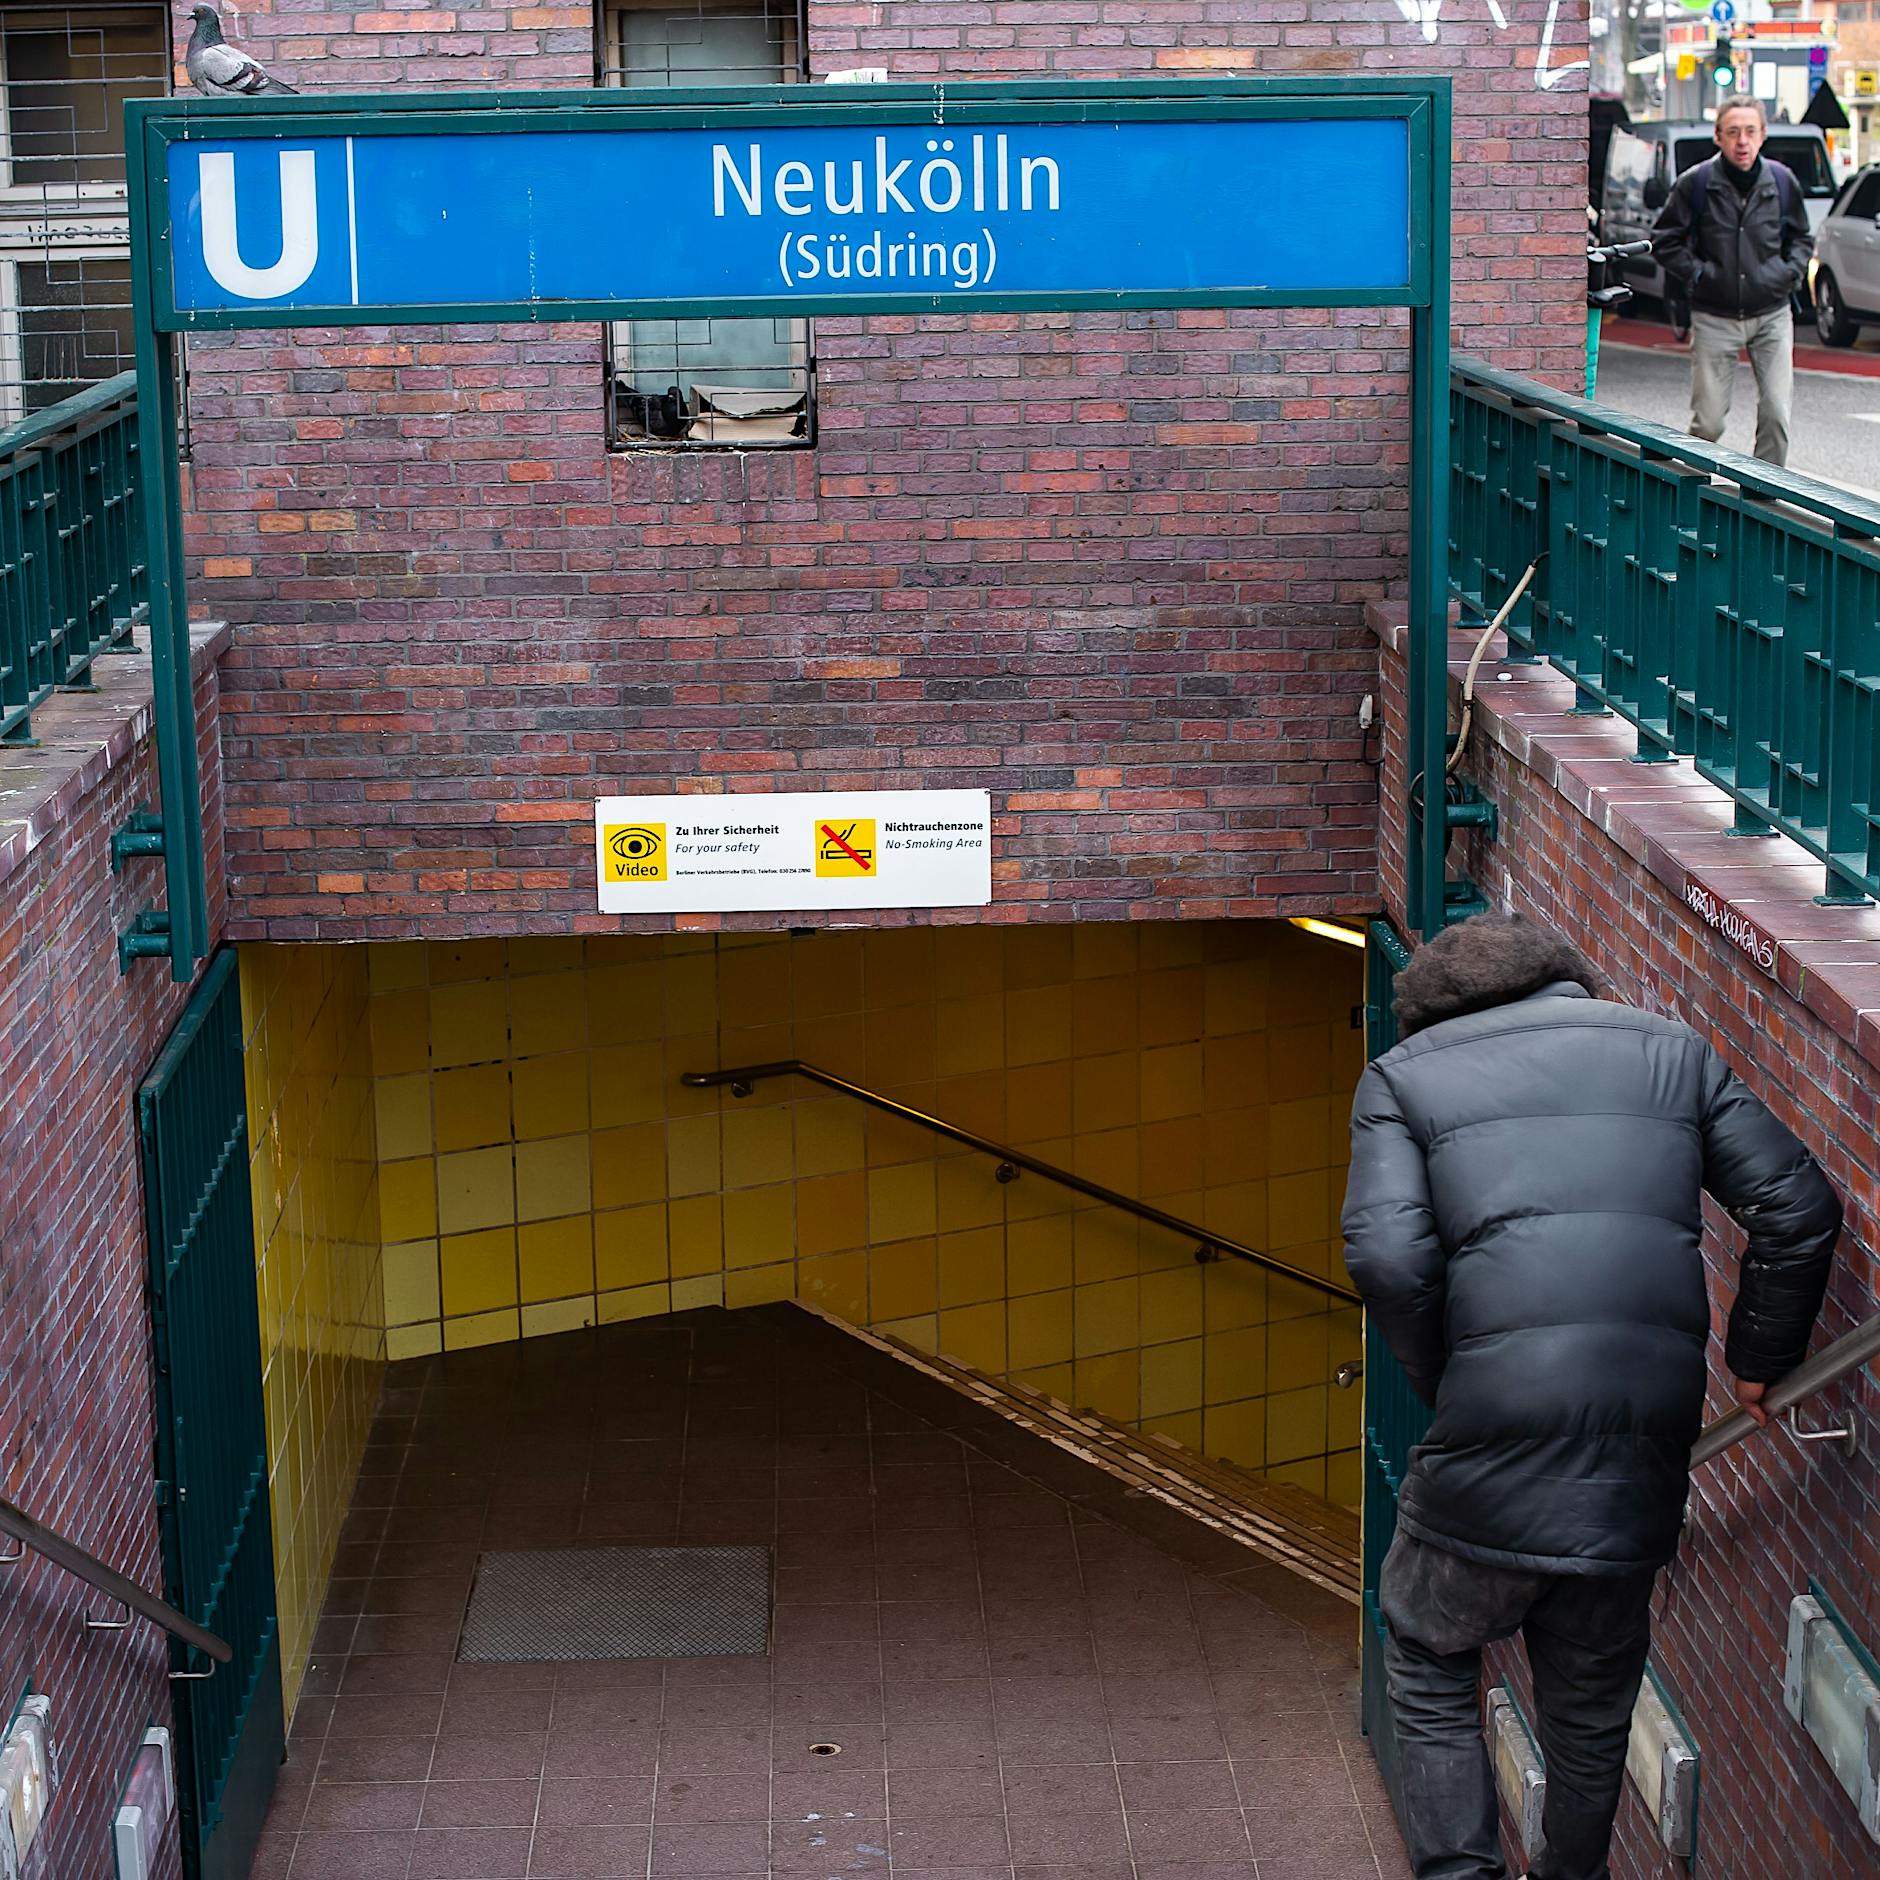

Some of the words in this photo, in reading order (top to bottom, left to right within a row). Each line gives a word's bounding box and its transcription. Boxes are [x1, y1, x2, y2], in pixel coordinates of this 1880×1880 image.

[713, 134, 1060, 217] Neukölln
[199, 151, 317, 298] U
[779, 228, 996, 288] (Südring)
[675, 826, 689, 836] Zu
[693, 825, 720, 836] Ihrer
[723, 824, 780, 835] Sicherheit
[884, 821, 984, 832] Nichtrauchenzone
[675, 843, 694, 854] For
[696, 844, 722, 856] your
[724, 841, 761, 855] safety
[885, 838, 954, 851] No-Smoking
[955, 838, 982, 849] Area
[615, 863, 659, 877] Video
